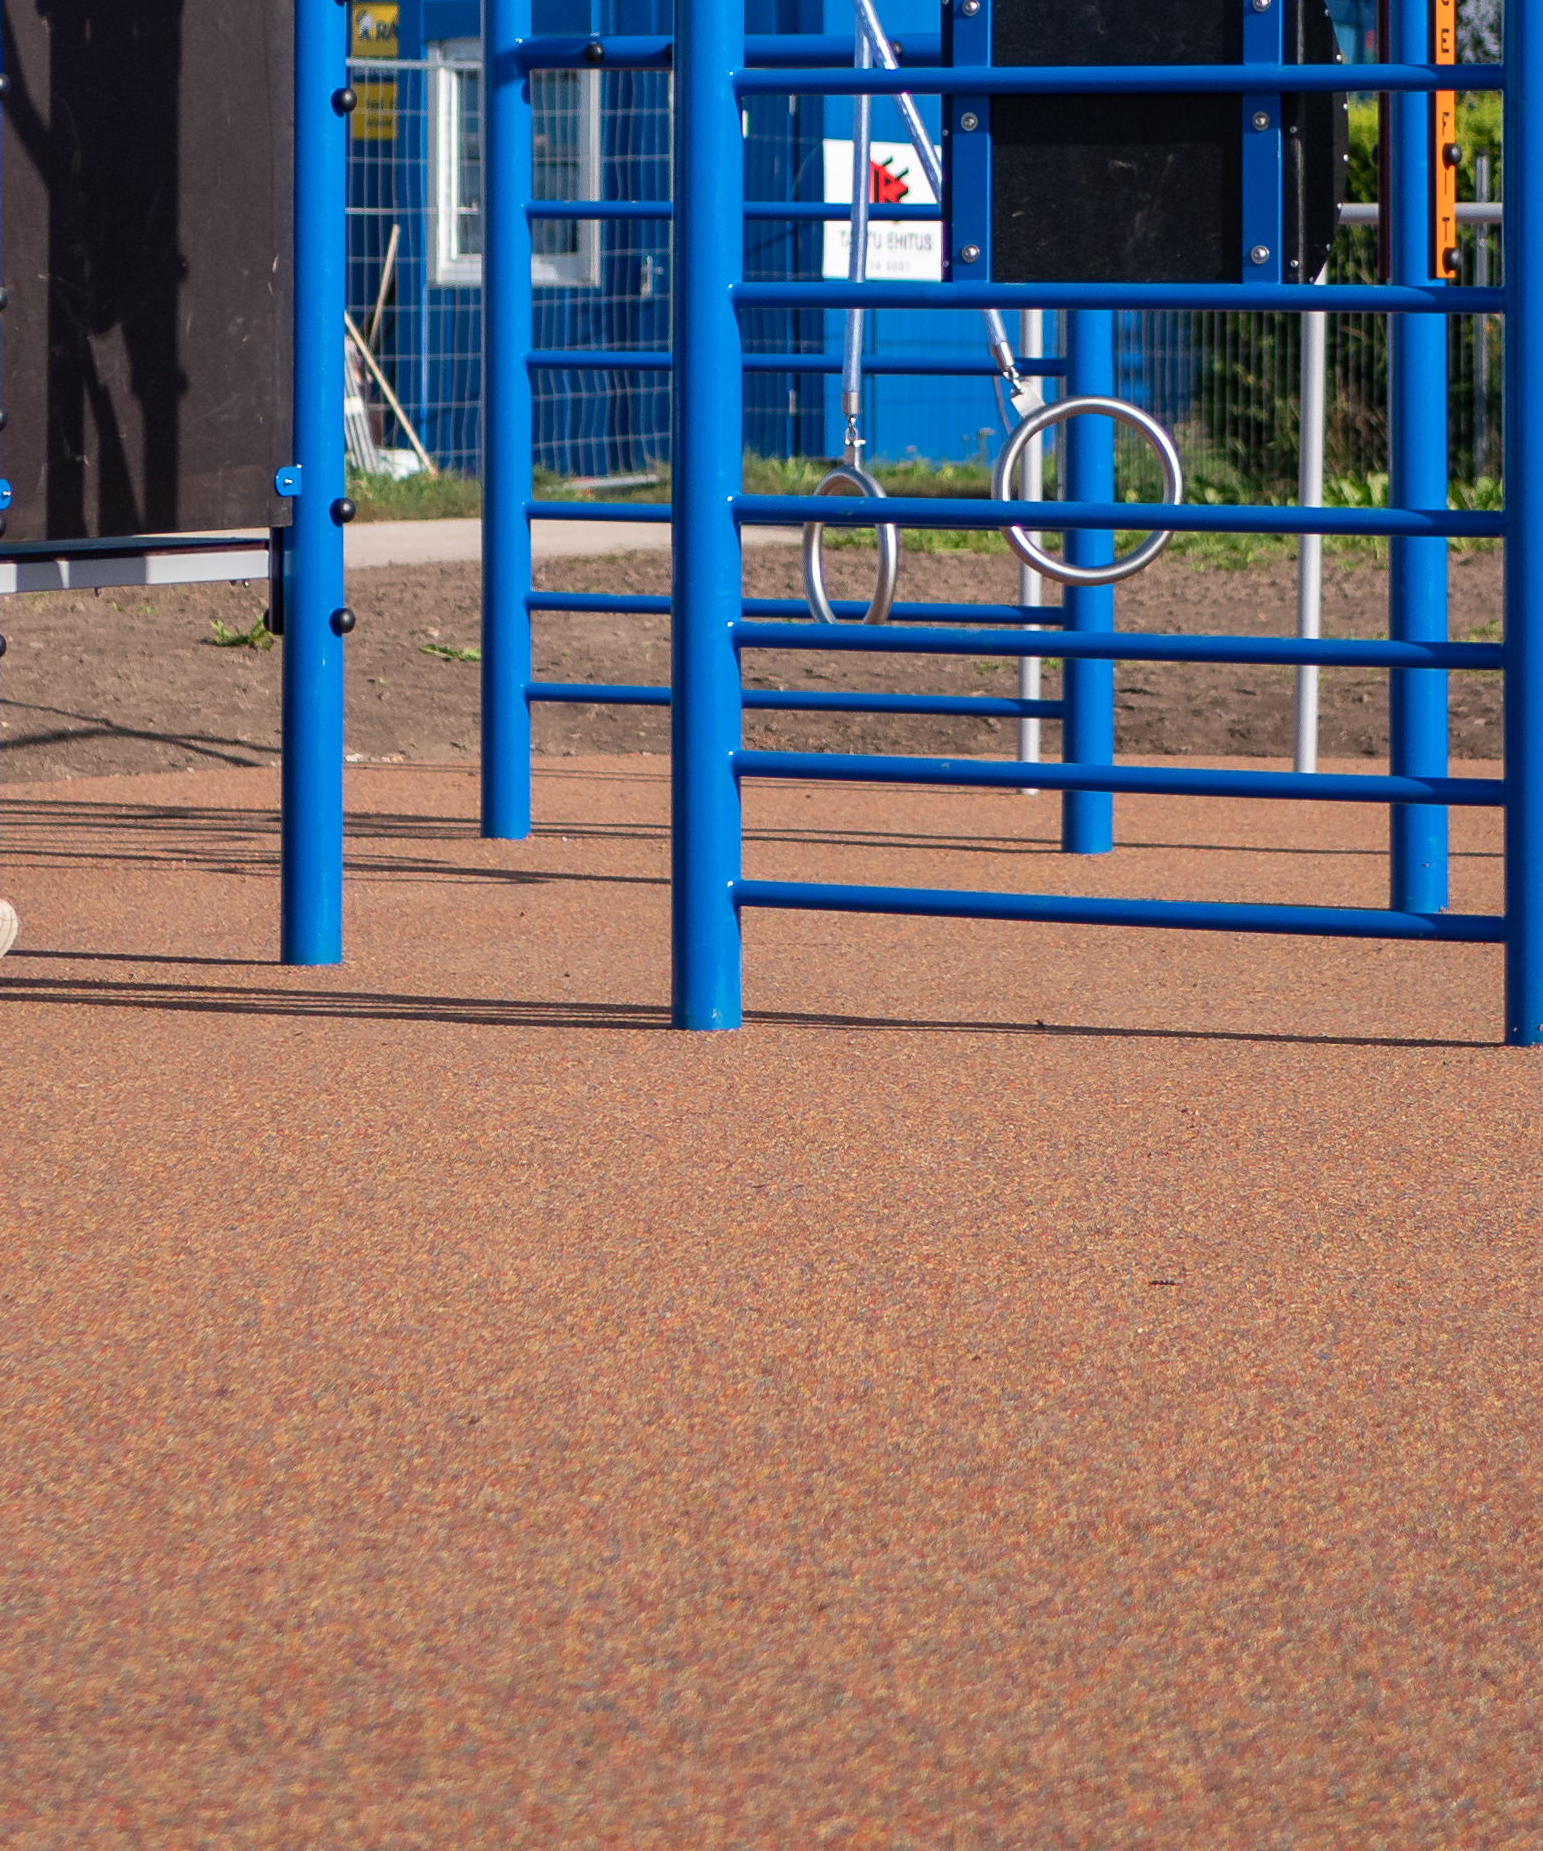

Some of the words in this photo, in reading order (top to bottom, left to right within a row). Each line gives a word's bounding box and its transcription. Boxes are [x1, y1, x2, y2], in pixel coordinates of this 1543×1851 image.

[1441, 111, 1450, 242] FIT
[840, 230, 882, 250] TTU
[886, 231, 933, 252] EHITUS
